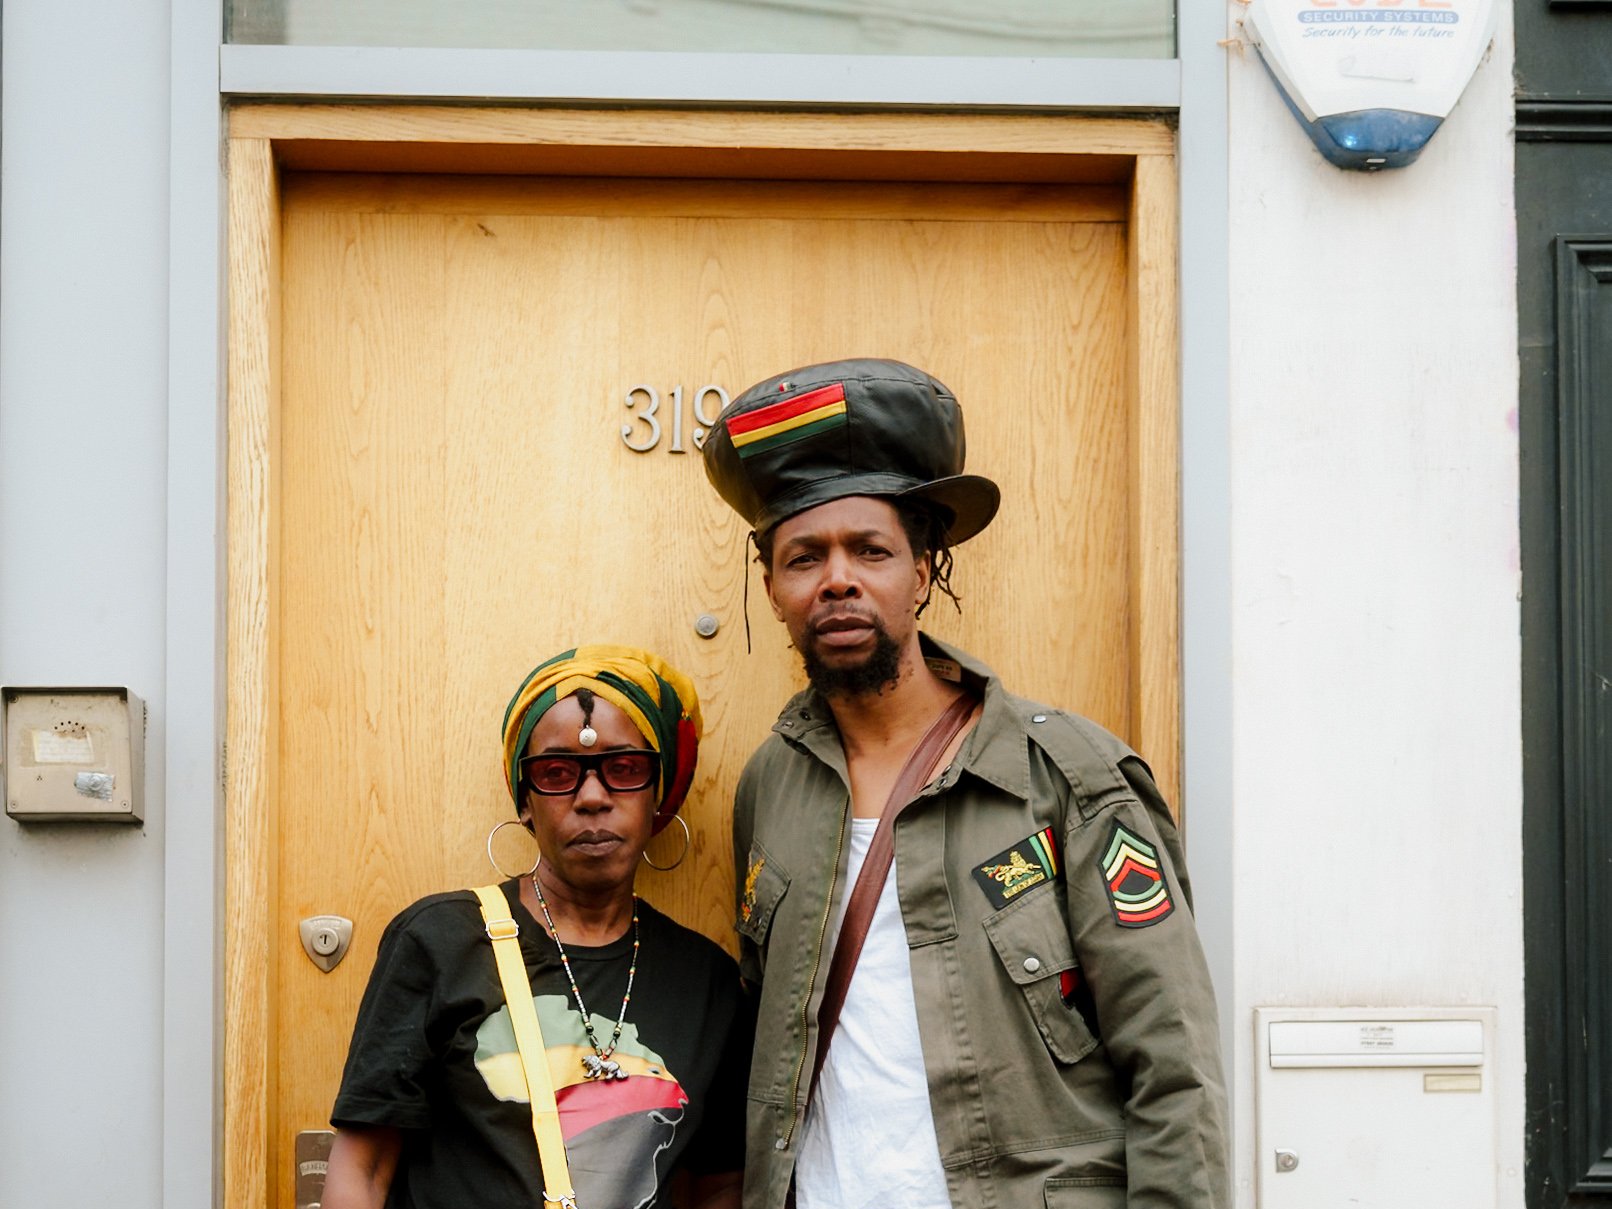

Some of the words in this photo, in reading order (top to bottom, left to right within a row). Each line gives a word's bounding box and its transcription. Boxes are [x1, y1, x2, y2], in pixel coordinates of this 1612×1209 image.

[1303, 11, 1377, 22] SECURITY
[1384, 12, 1455, 23] SYSTEMS
[1302, 27, 1361, 39] Security
[1364, 25, 1385, 37] for
[1388, 26, 1408, 37] the
[1412, 26, 1456, 38] future
[620, 384, 731, 453] 319
